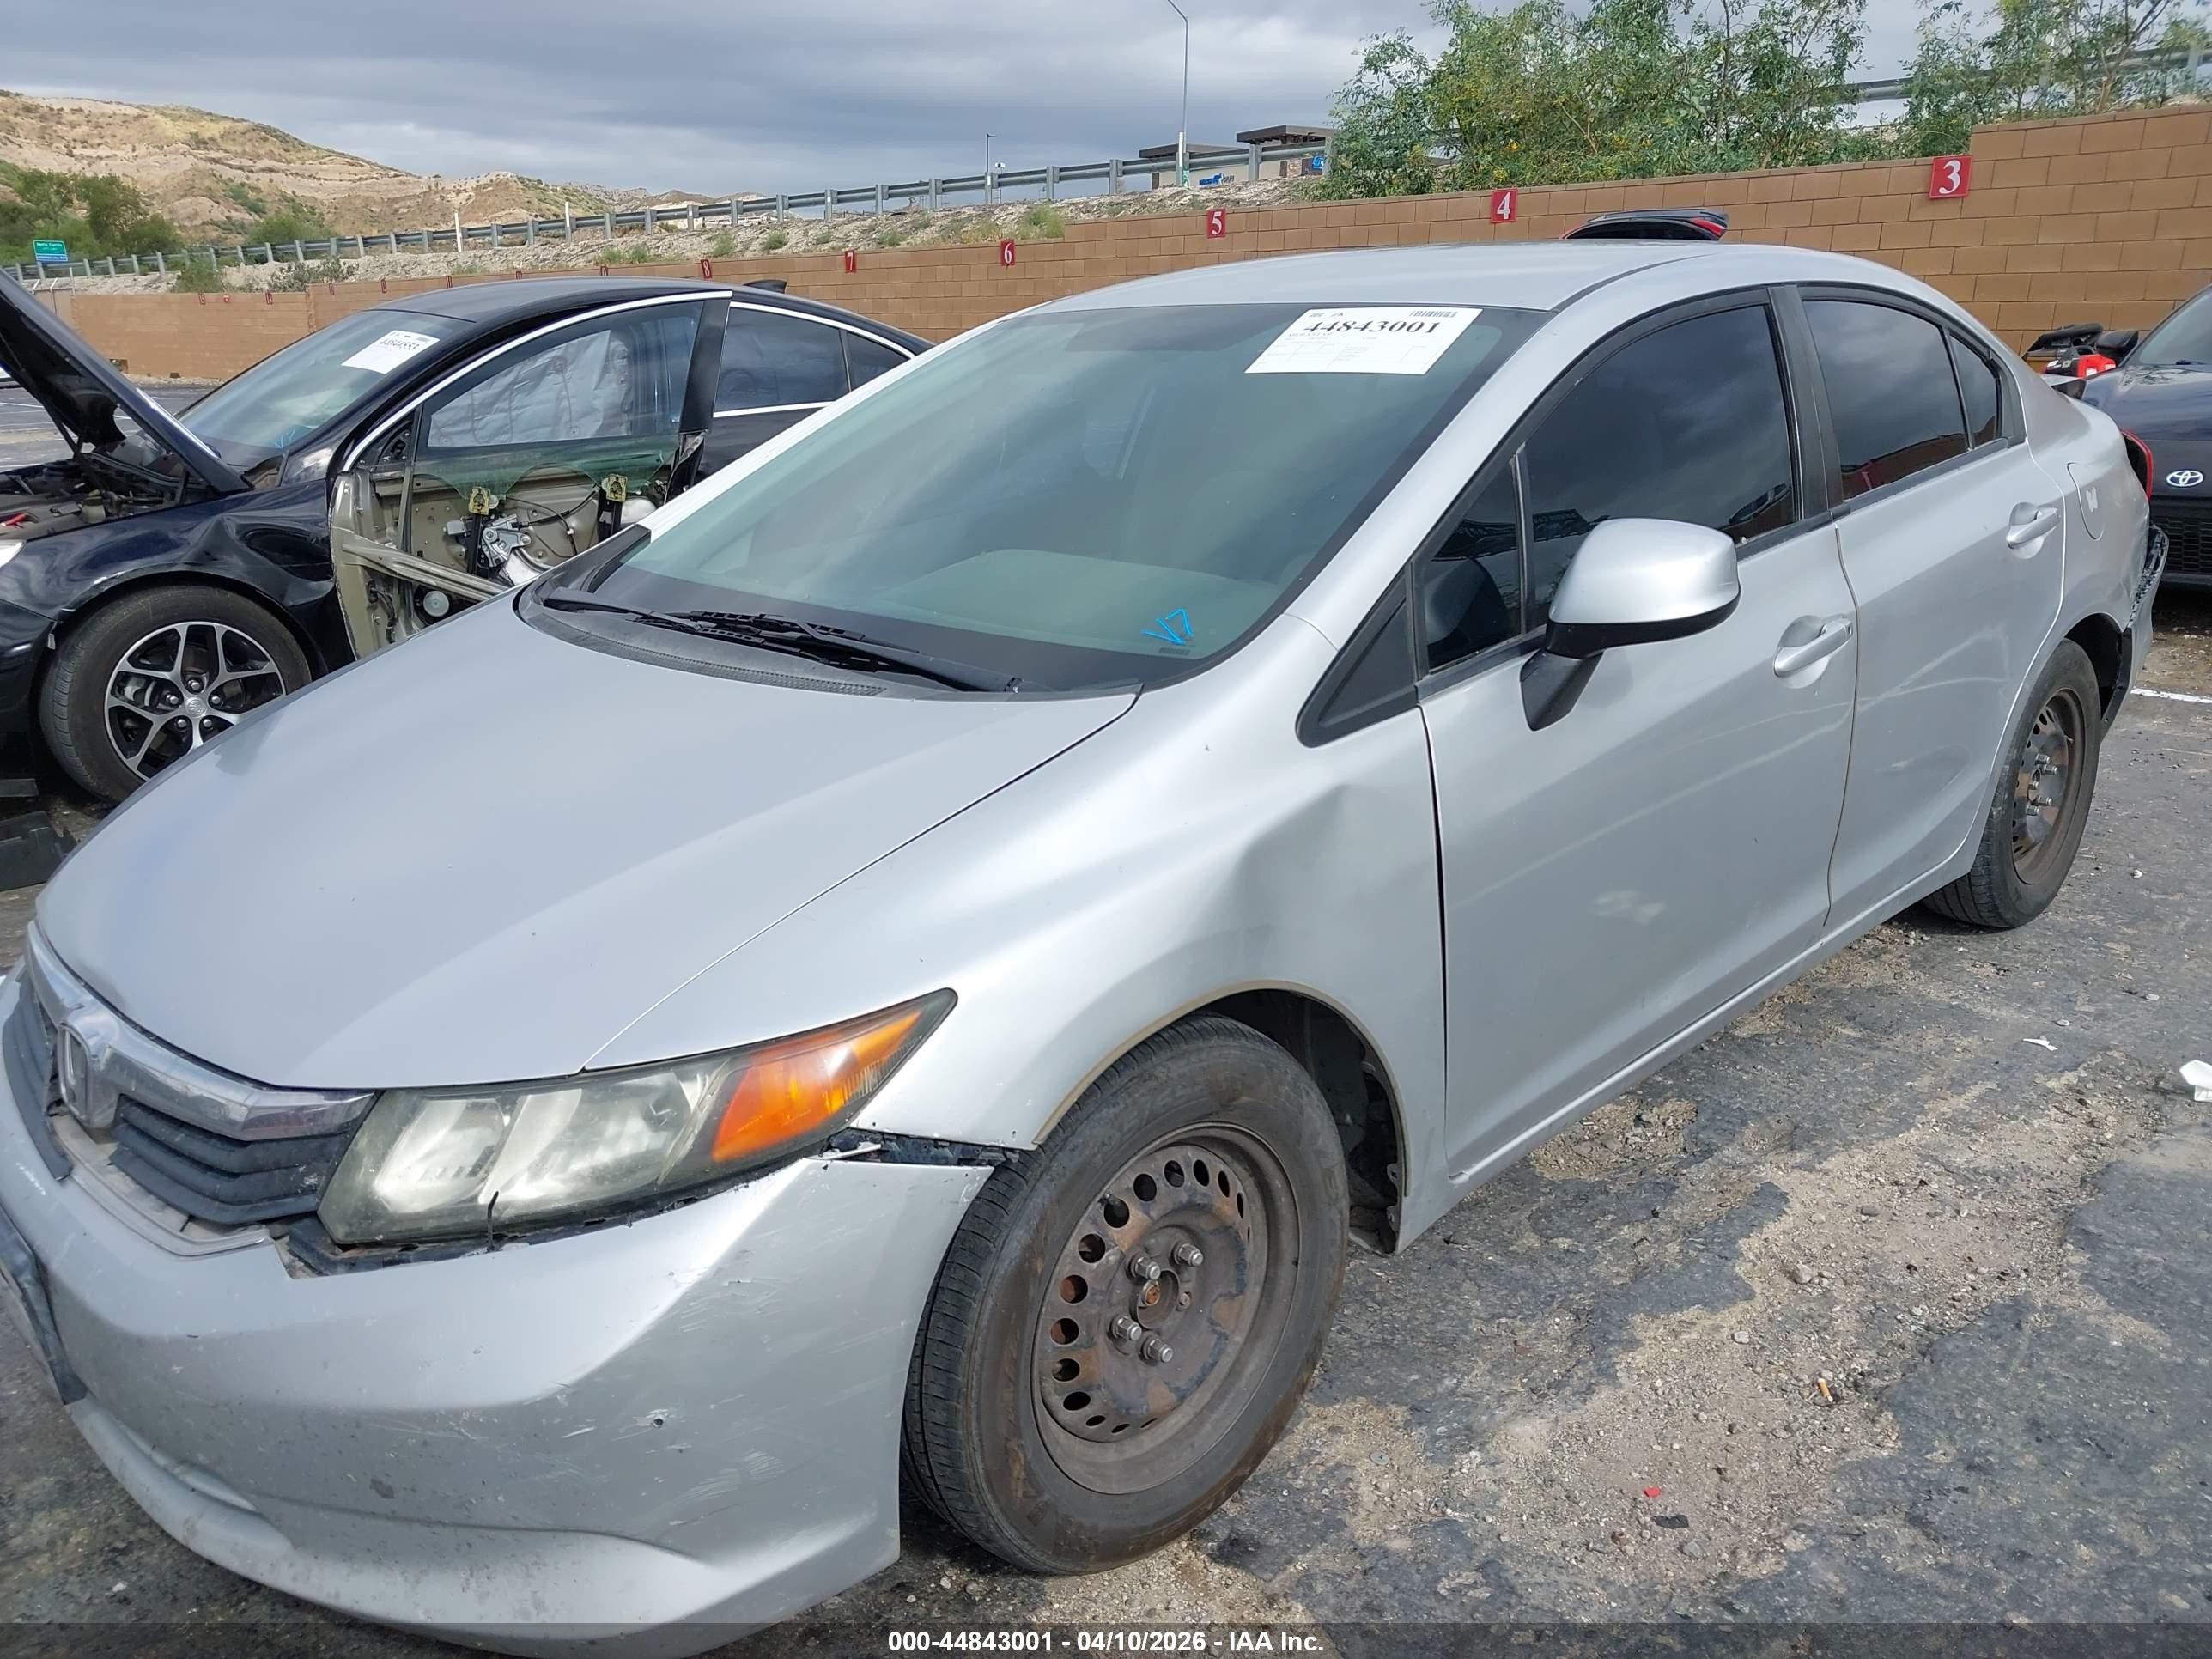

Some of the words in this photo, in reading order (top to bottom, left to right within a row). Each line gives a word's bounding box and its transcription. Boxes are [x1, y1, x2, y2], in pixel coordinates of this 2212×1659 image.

[1939, 160, 1961, 194] 3
[1497, 191, 1511, 220] 4
[1212, 211, 1222, 235] 5
[847, 252, 854, 270] 7
[1004, 242, 1012, 264] 6
[702, 260, 711, 276] 8
[1304, 320, 1441, 333] 44843001
